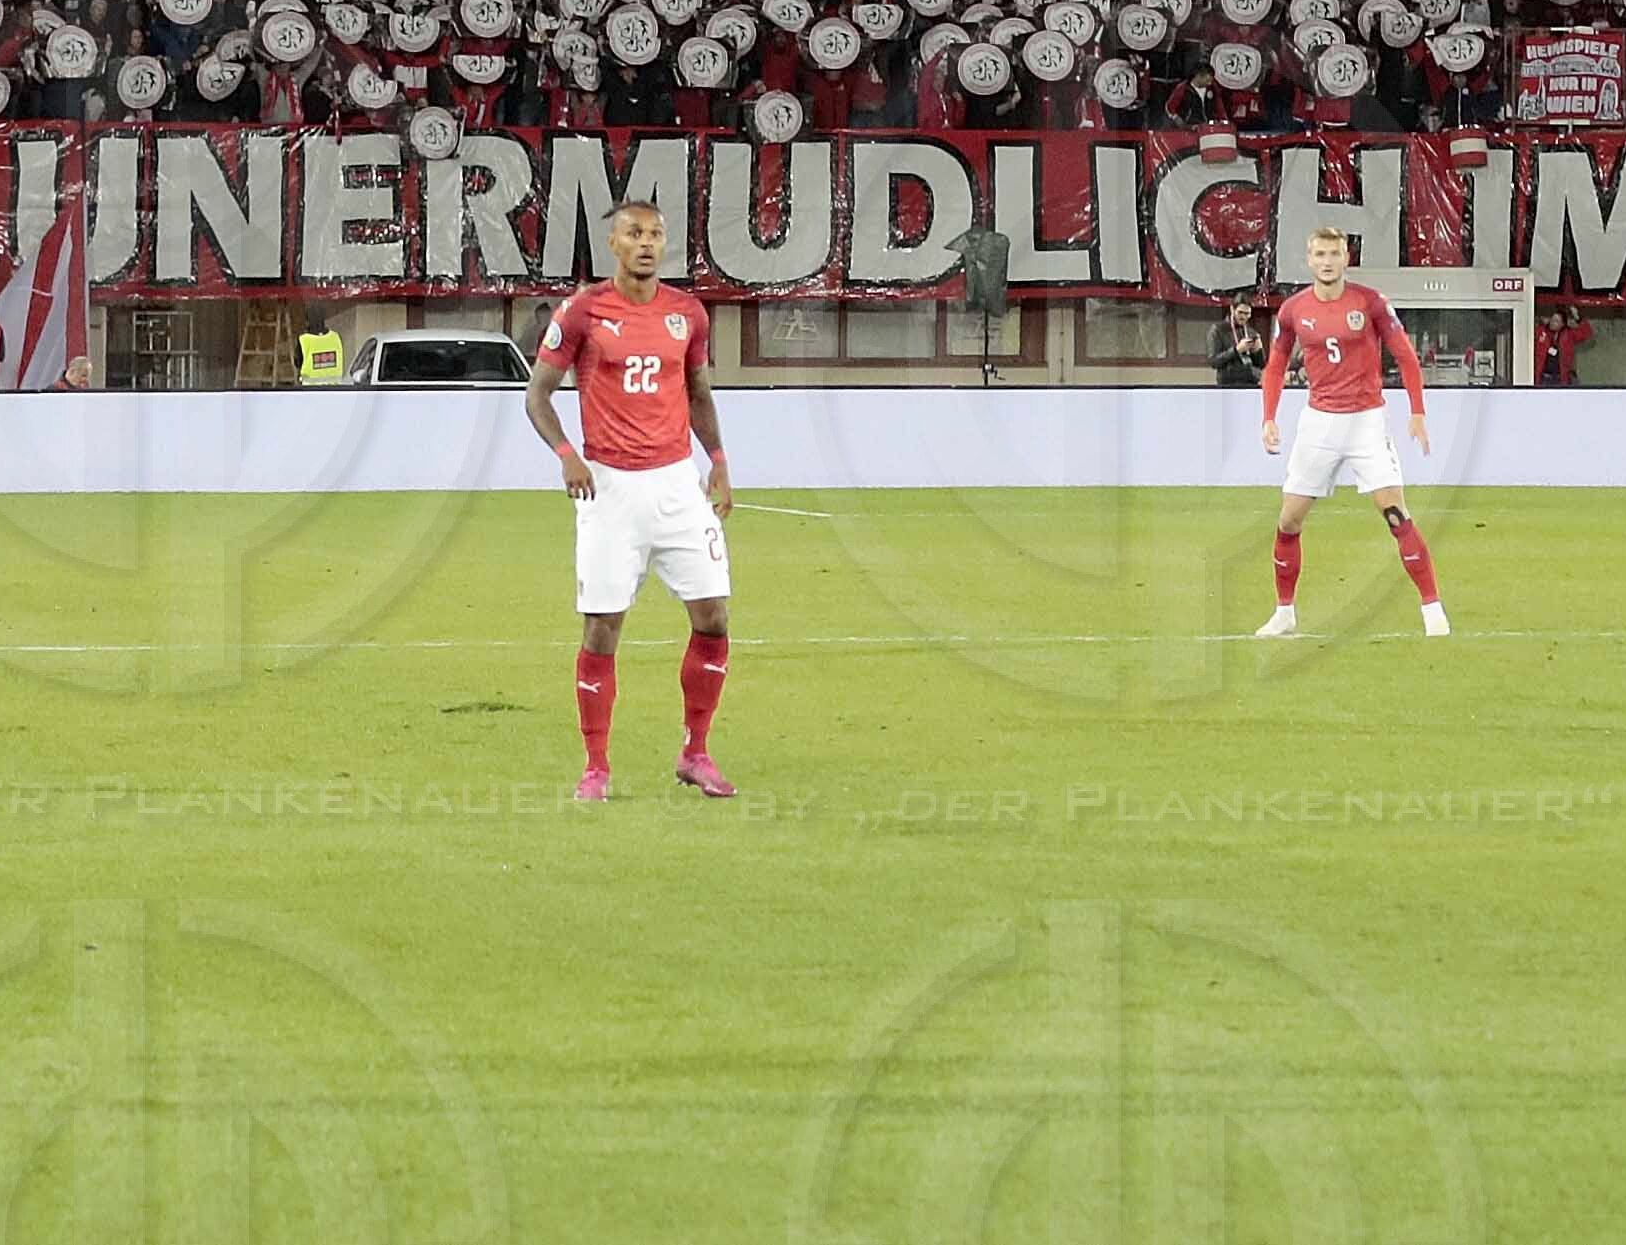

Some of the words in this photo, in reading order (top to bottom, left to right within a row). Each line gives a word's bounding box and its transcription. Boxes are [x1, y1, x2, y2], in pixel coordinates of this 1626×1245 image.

[1526, 38, 1620, 60] HEIMSPIELE
[1549, 77, 1578, 91] NUR
[1581, 77, 1598, 91] IN
[1547, 96, 1596, 113] WIEN
[1493, 280, 1523, 291] ORF
[1325, 336, 1343, 364] 5
[623, 355, 662, 394] 22
[704, 527, 727, 562] 2
